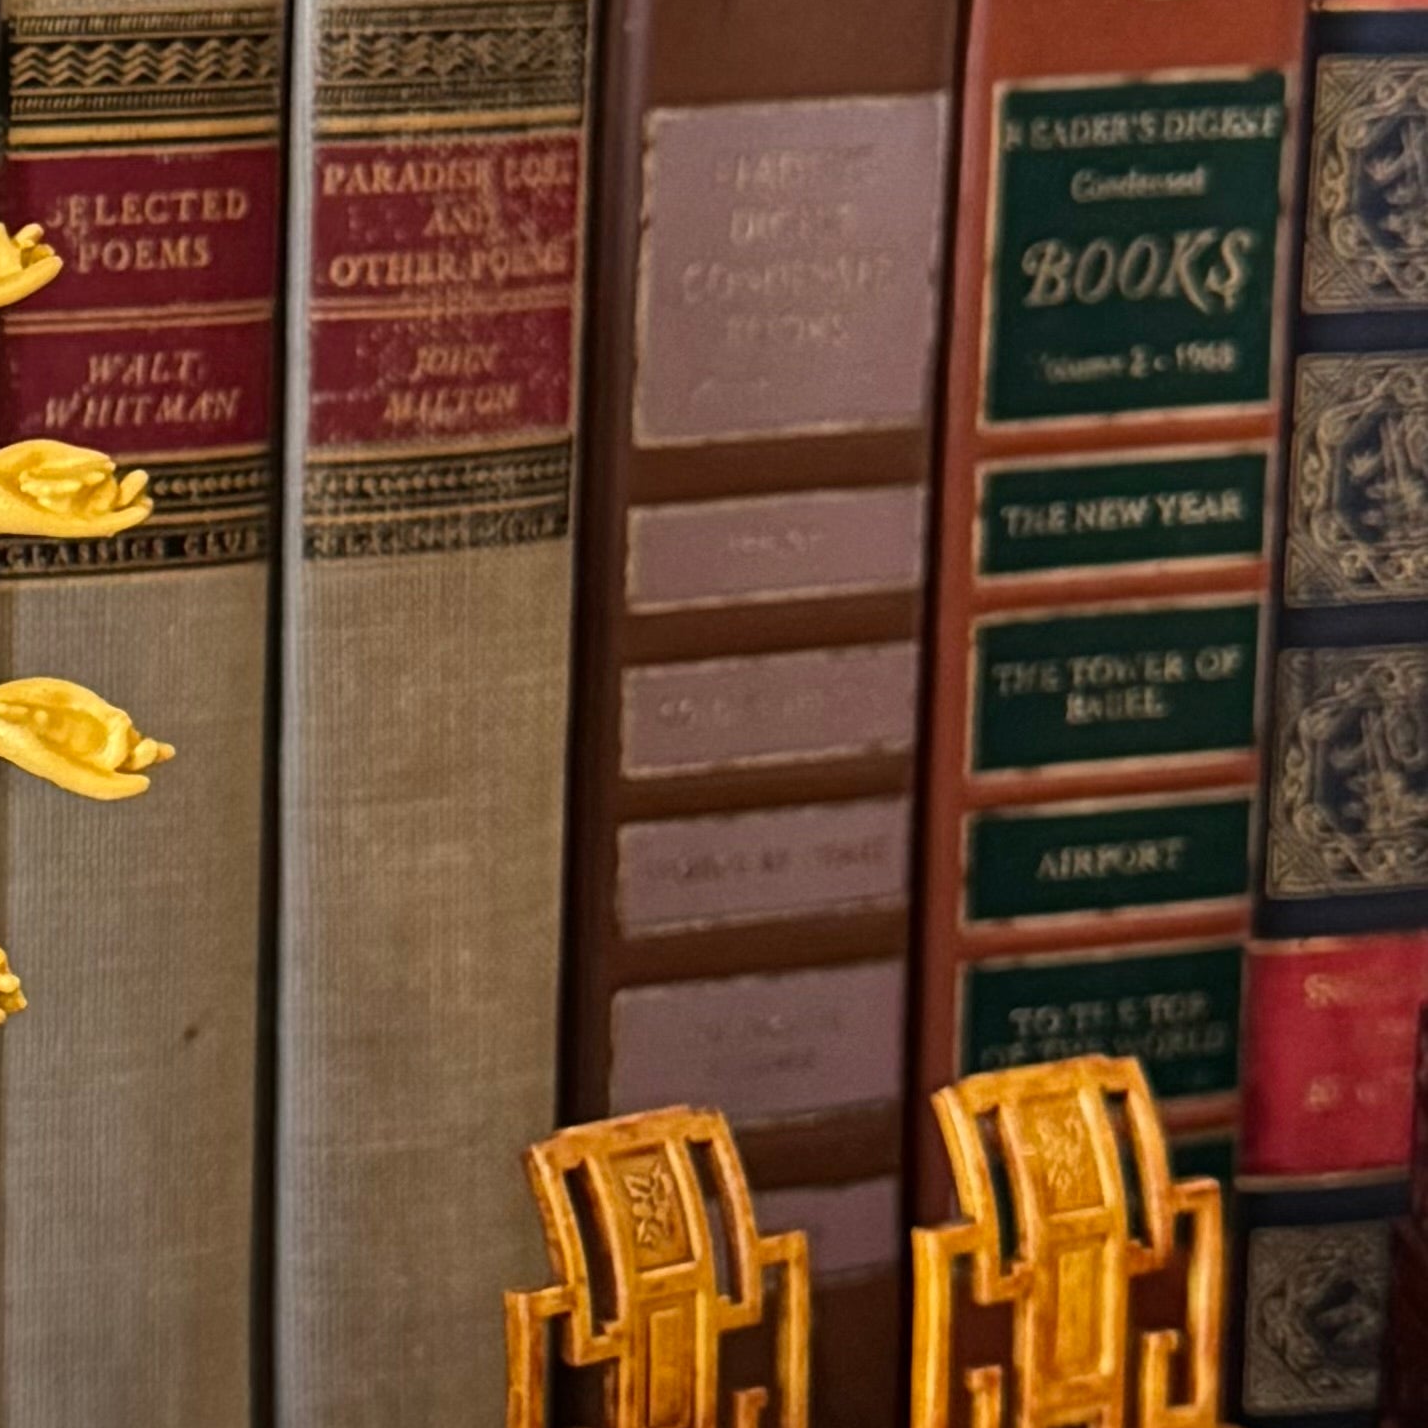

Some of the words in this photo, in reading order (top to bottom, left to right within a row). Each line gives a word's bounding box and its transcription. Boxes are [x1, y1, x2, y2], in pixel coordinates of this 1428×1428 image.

[46, 188, 249, 229] SELECTED
[76, 235, 212, 274] POEMS
[328, 250, 462, 288] OTHER
[1021, 226, 1257, 313] BOOKS
[87, 350, 200, 386] WALT
[408, 342, 499, 384] JOHN
[43, 387, 241, 429] WHITMAN
[383, 382, 522, 422] MILTON
[1000, 500, 1066, 538] THE
[1074, 496, 1148, 532] NEW
[1155, 488, 1243, 526] YEAR
[1037, 836, 1186, 880] AIRPORT
